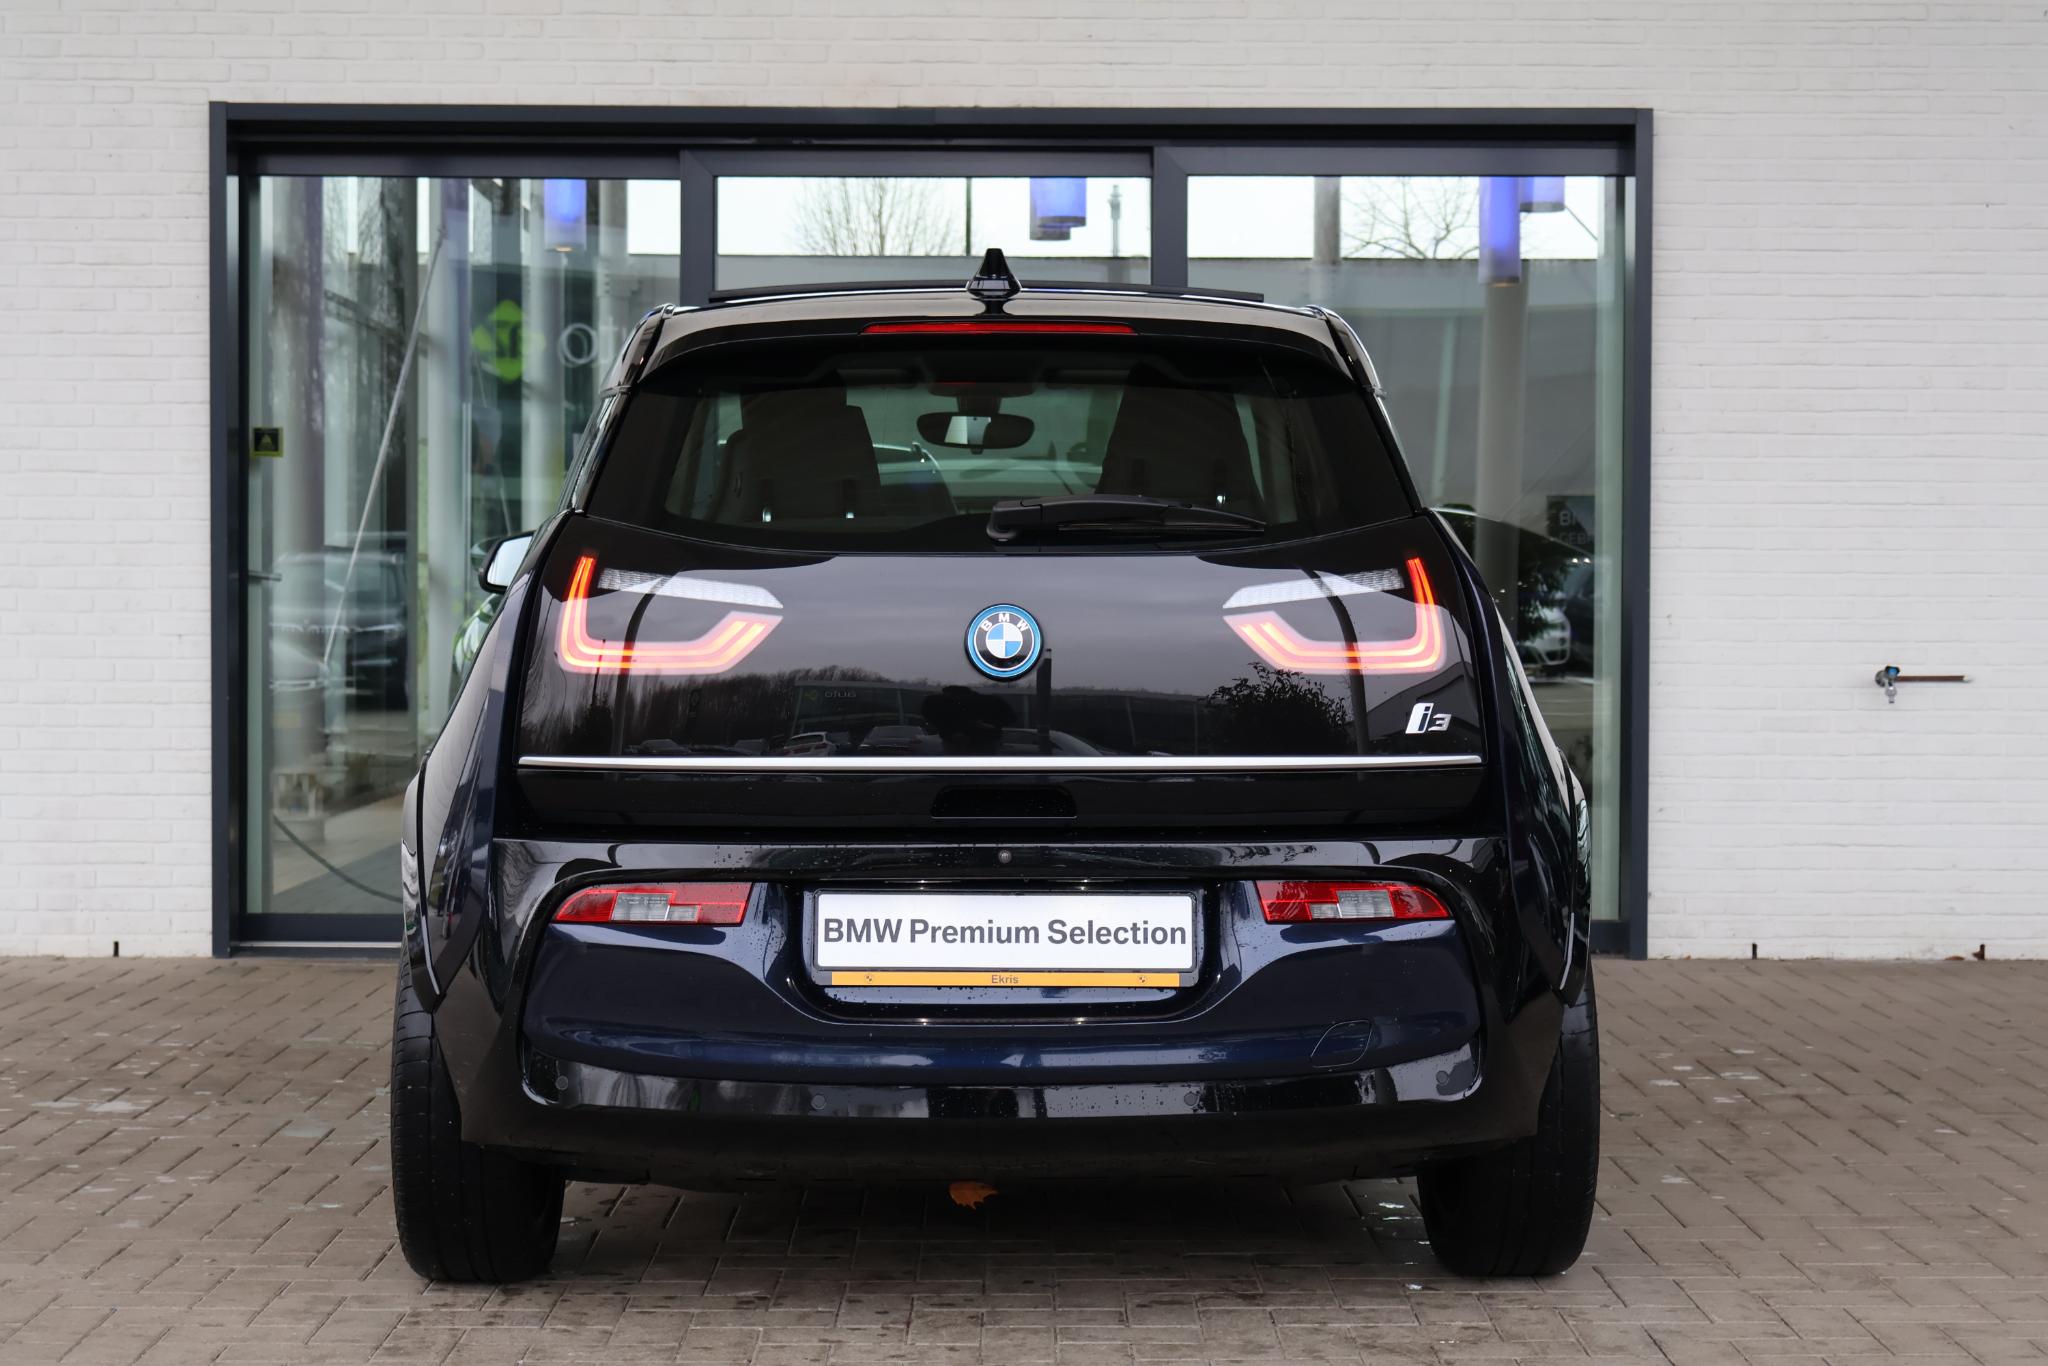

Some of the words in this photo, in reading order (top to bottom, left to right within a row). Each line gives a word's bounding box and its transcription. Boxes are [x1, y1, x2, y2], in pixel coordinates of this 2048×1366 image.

[980, 612, 1029, 632] BMW
[1405, 702, 1452, 734] i3
[824, 918, 902, 942] BMW
[910, 919, 1039, 943] Premium
[1047, 919, 1186, 944] Selection
[991, 974, 1019, 984] Ekris
